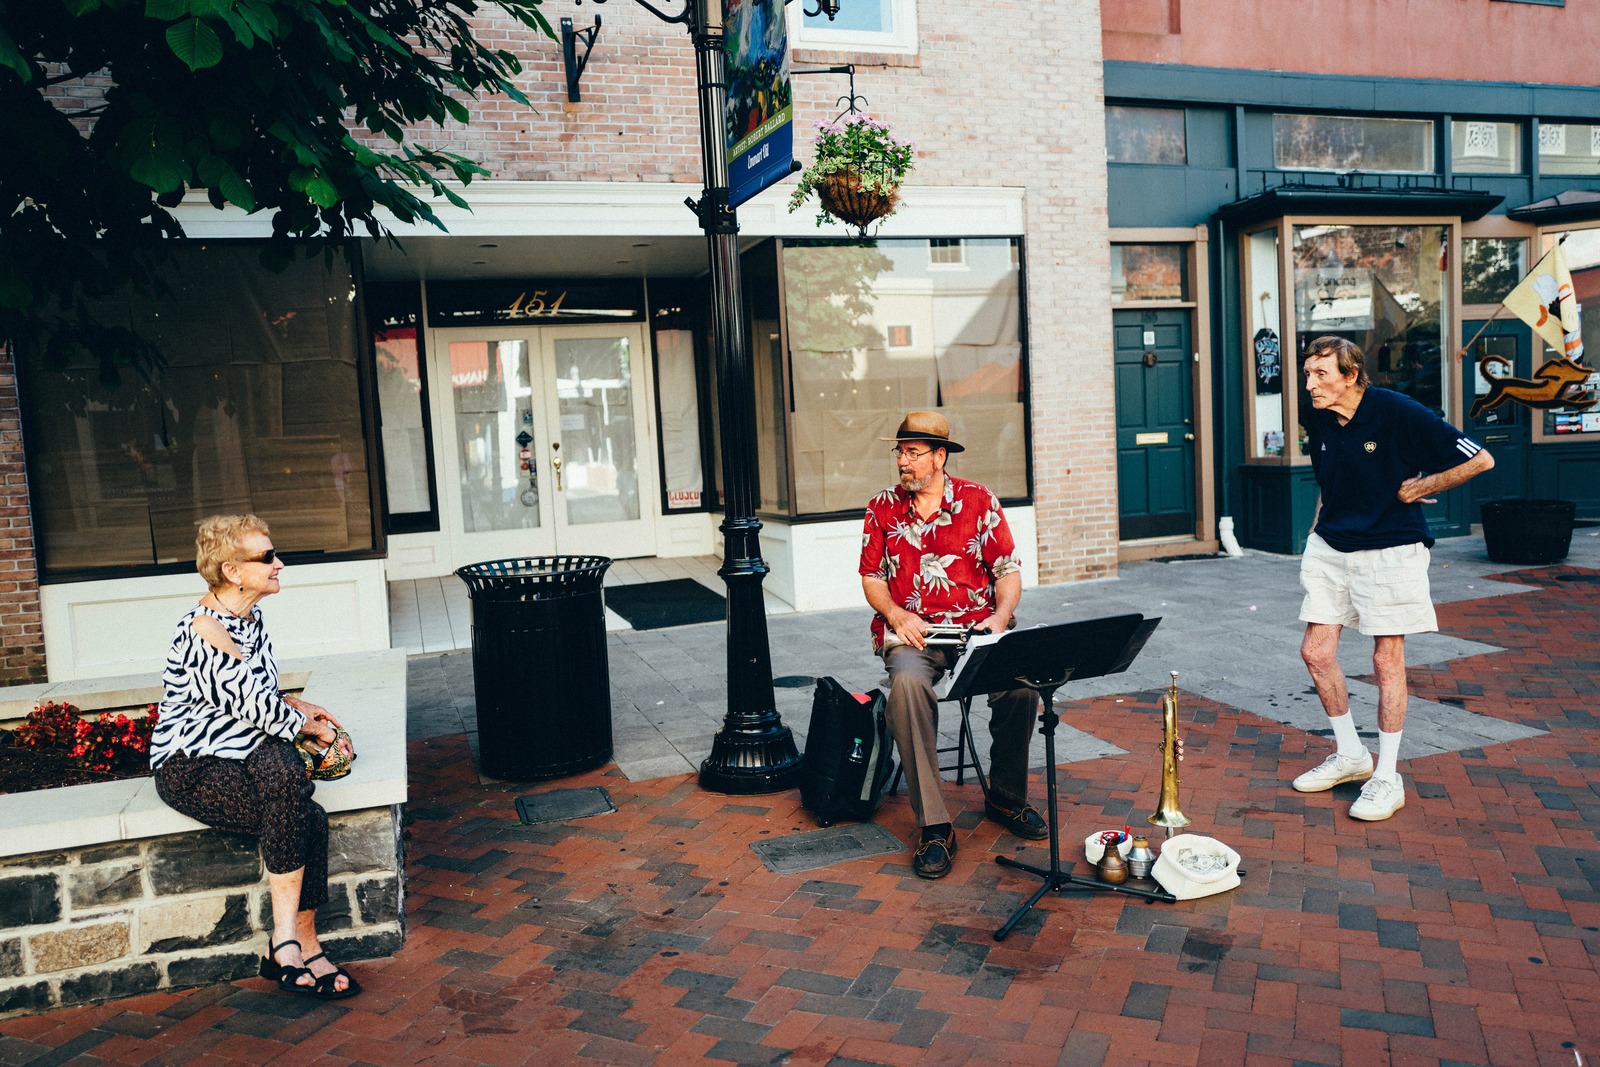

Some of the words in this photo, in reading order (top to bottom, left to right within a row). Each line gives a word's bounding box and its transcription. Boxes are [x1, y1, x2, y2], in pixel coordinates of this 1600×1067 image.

[733, 140, 747, 157] ARTIST:
[748, 128, 764, 146] ROBERT
[764, 113, 785, 133] BALLARD
[509, 289, 567, 317] 151
[1261, 366, 1277, 376] SALE
